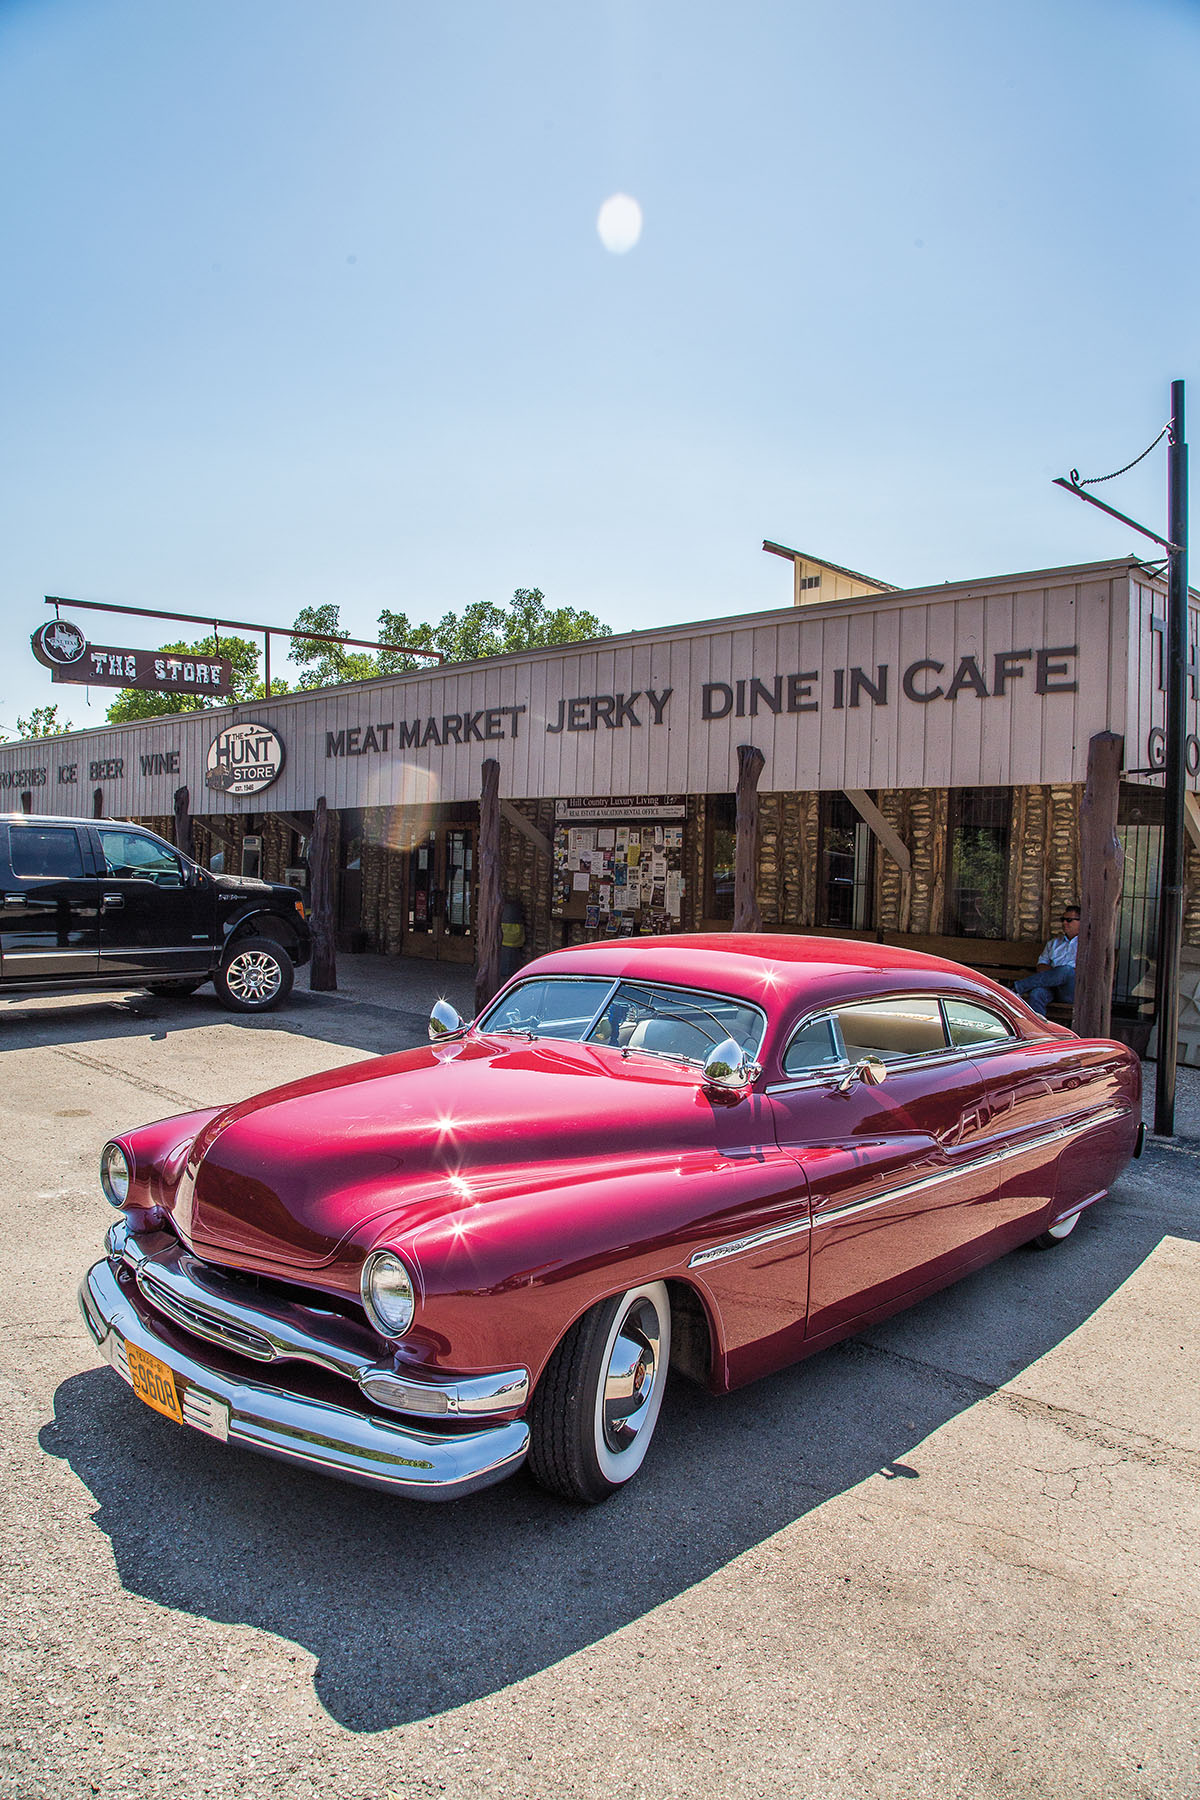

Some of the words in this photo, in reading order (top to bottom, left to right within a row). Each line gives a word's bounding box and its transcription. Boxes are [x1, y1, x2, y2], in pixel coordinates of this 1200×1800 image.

[90, 652, 137, 678] THE
[154, 659, 222, 684] STORE
[702, 670, 819, 720] DINE
[832, 664, 889, 709] IN
[902, 645, 1077, 702] CAFE
[546, 688, 673, 734] JERKY
[232, 732, 244, 740] THE
[326, 723, 394, 758] MEAT
[399, 704, 526, 749] MARKET
[140, 750, 181, 776] WINE
[216, 734, 273, 769] HUNT
[58, 763, 78, 785] ICE
[89, 758, 124, 781] BEER
[234, 767, 272, 780] STORE
[569, 798, 582, 807] Hill
[583, 797, 608, 808] Country
[610, 796, 634, 807] Luxury
[636, 795, 659, 806] Living
[138, 1365, 176, 1412] 9608
